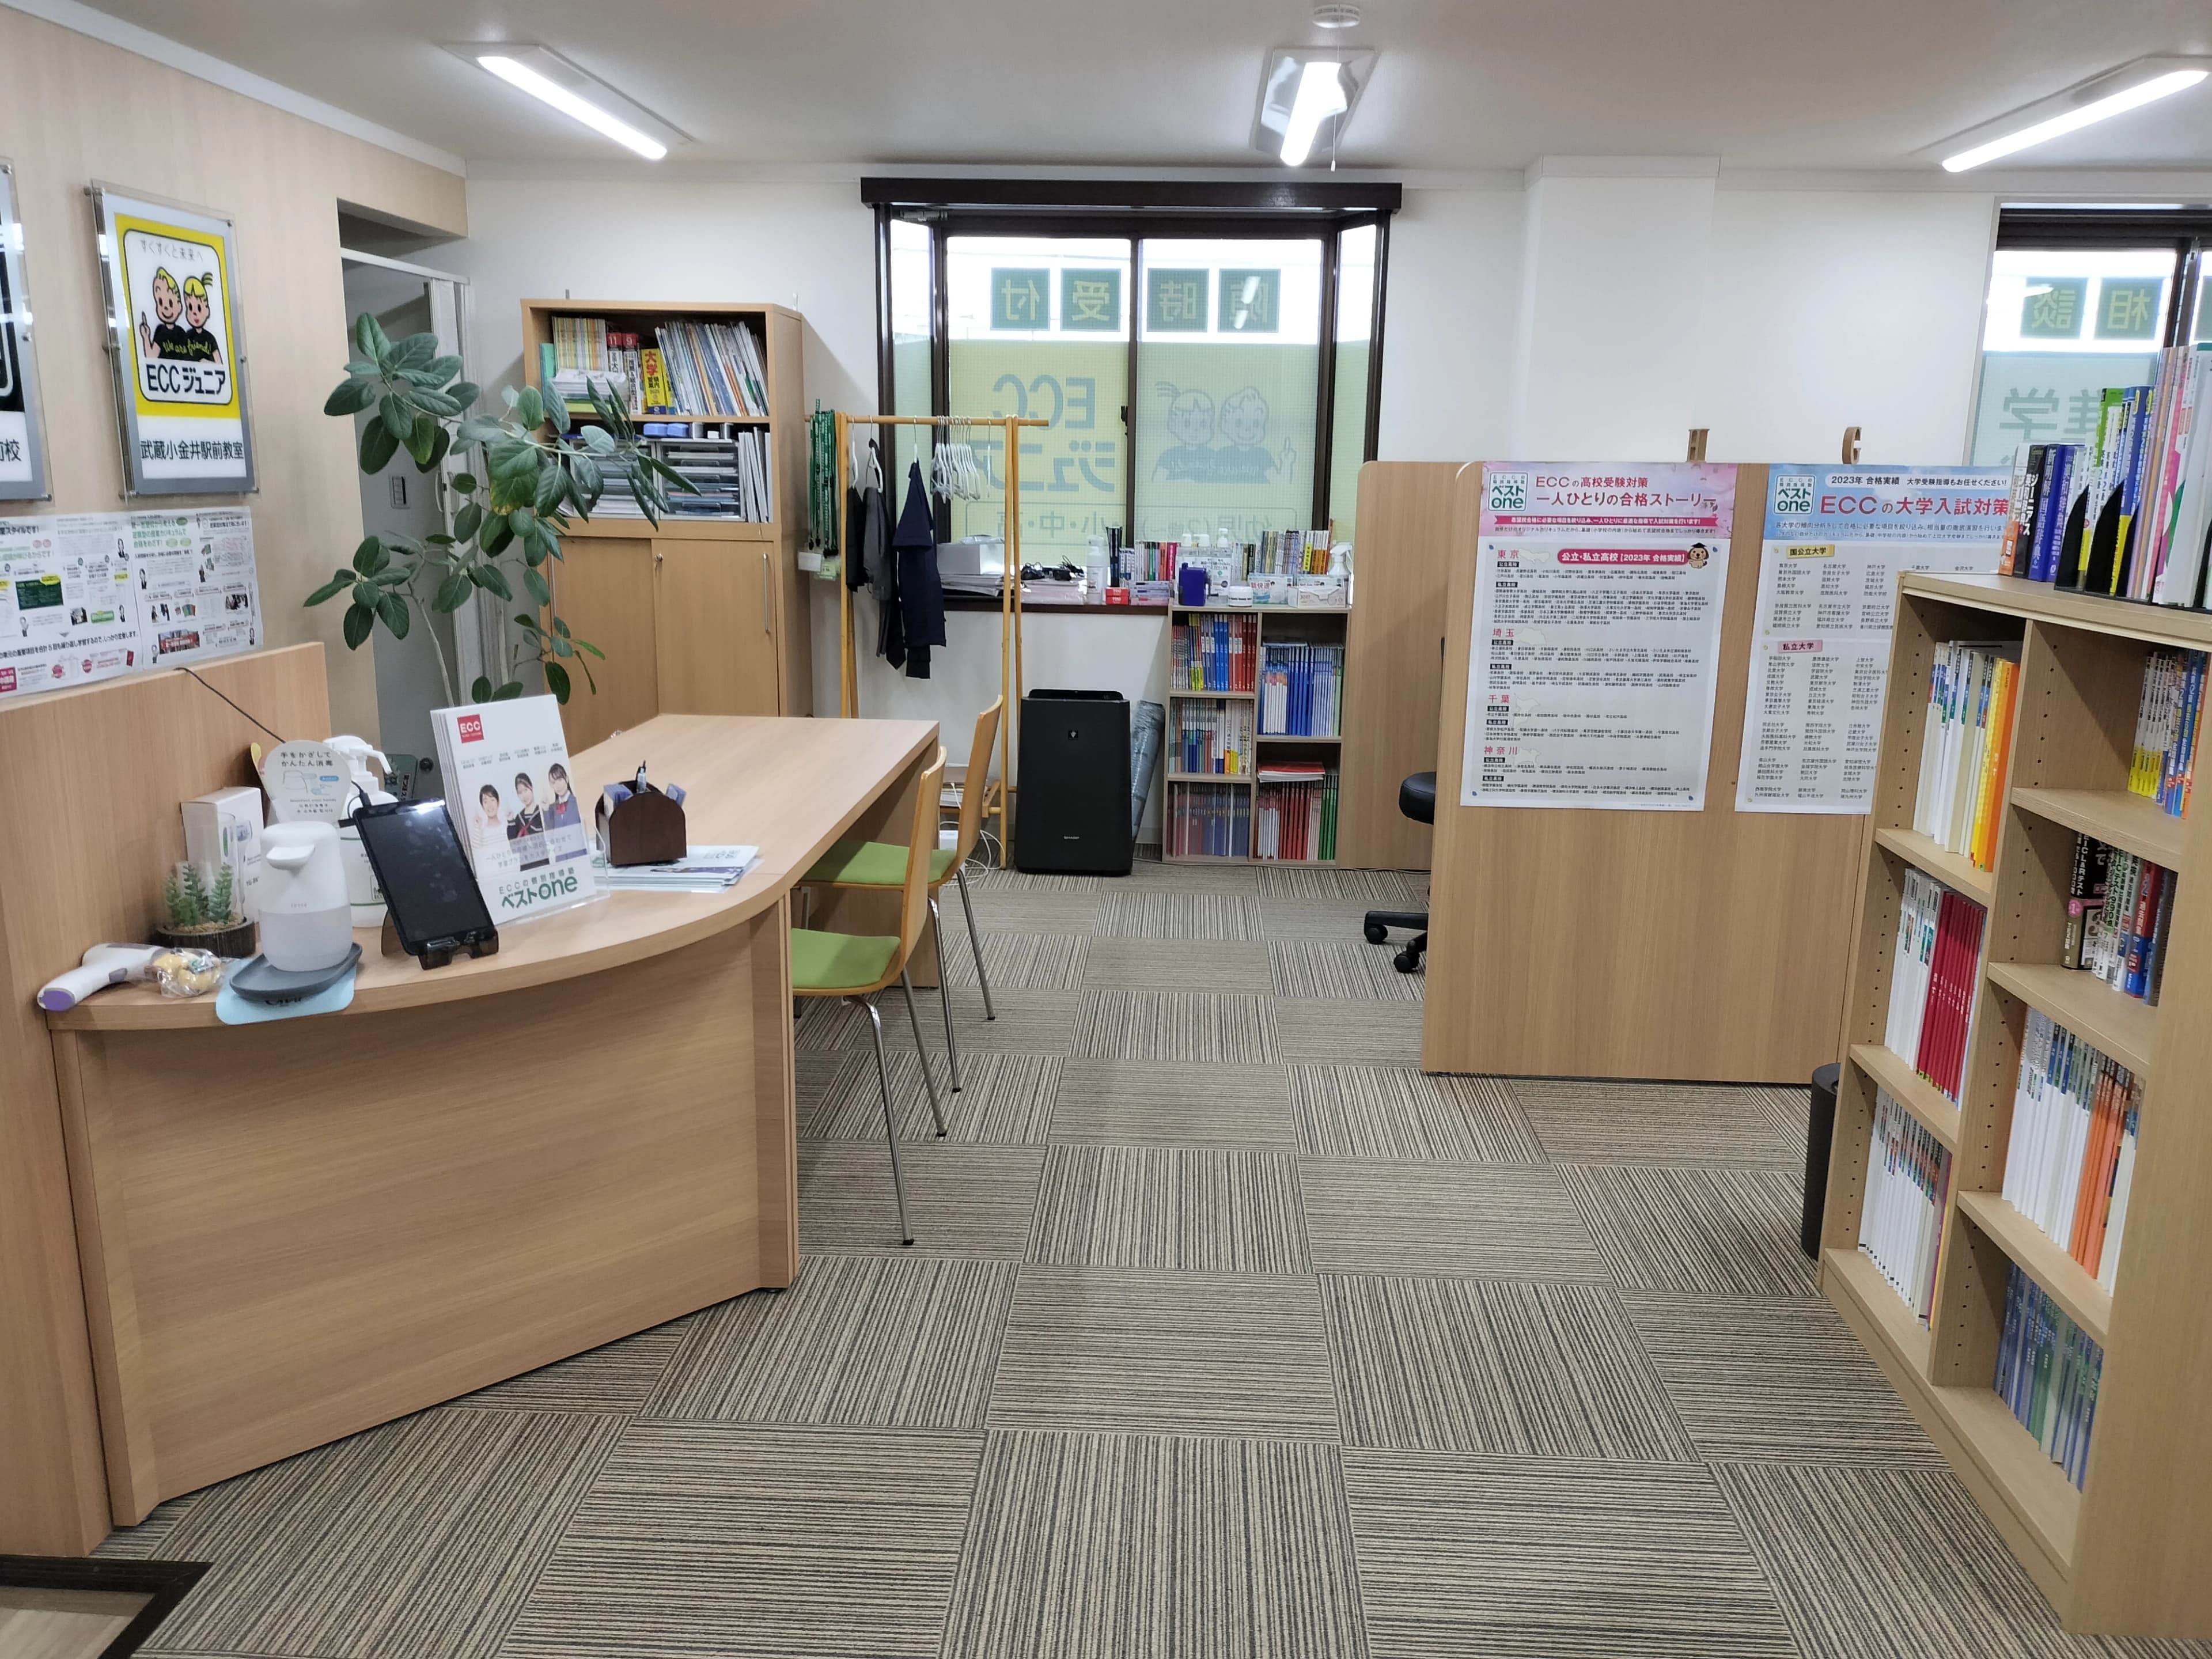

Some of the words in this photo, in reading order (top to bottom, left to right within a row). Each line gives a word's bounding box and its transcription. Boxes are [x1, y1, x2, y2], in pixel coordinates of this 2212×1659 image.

[141, 240, 203, 262] すくすくと未来へ
[645, 350, 658, 376] 大学
[146, 364, 226, 395] ECCジュニア
[141, 440, 244, 460] 武蔵小金井駅前教室
[1536, 476, 1649, 488] ECCの高校受験対策
[1831, 475, 1863, 485] 2023年
[1866, 476, 1900, 486] 合格実績
[1907, 477, 2008, 487] 大学受験指導もお任せください!
[1491, 485, 1524, 496] ベスト
[1778, 488, 1811, 499] ベスト
[1491, 497, 1524, 509] one
[1536, 492, 1717, 507] 一人ひとりの合格ストーリー
[1820, 495, 2009, 516] ECCの大学入試対策
[2023, 474, 2039, 536] ジーニアス
[1777, 500, 1810, 512] one
[1776, 522, 2005, 532] 各大学の傾向分析をして合格に必要な項目を絞り込み、相当量の徹底演習を行いま
[1497, 550, 1520, 559] 東京
[1562, 551, 1619, 563] 公立・私立高校
[1493, 628, 1514, 637] 埼玉
[1488, 695, 1510, 703] 千葉
[460, 720, 481, 733] ECC
[1484, 746, 1517, 755] 神奈川
